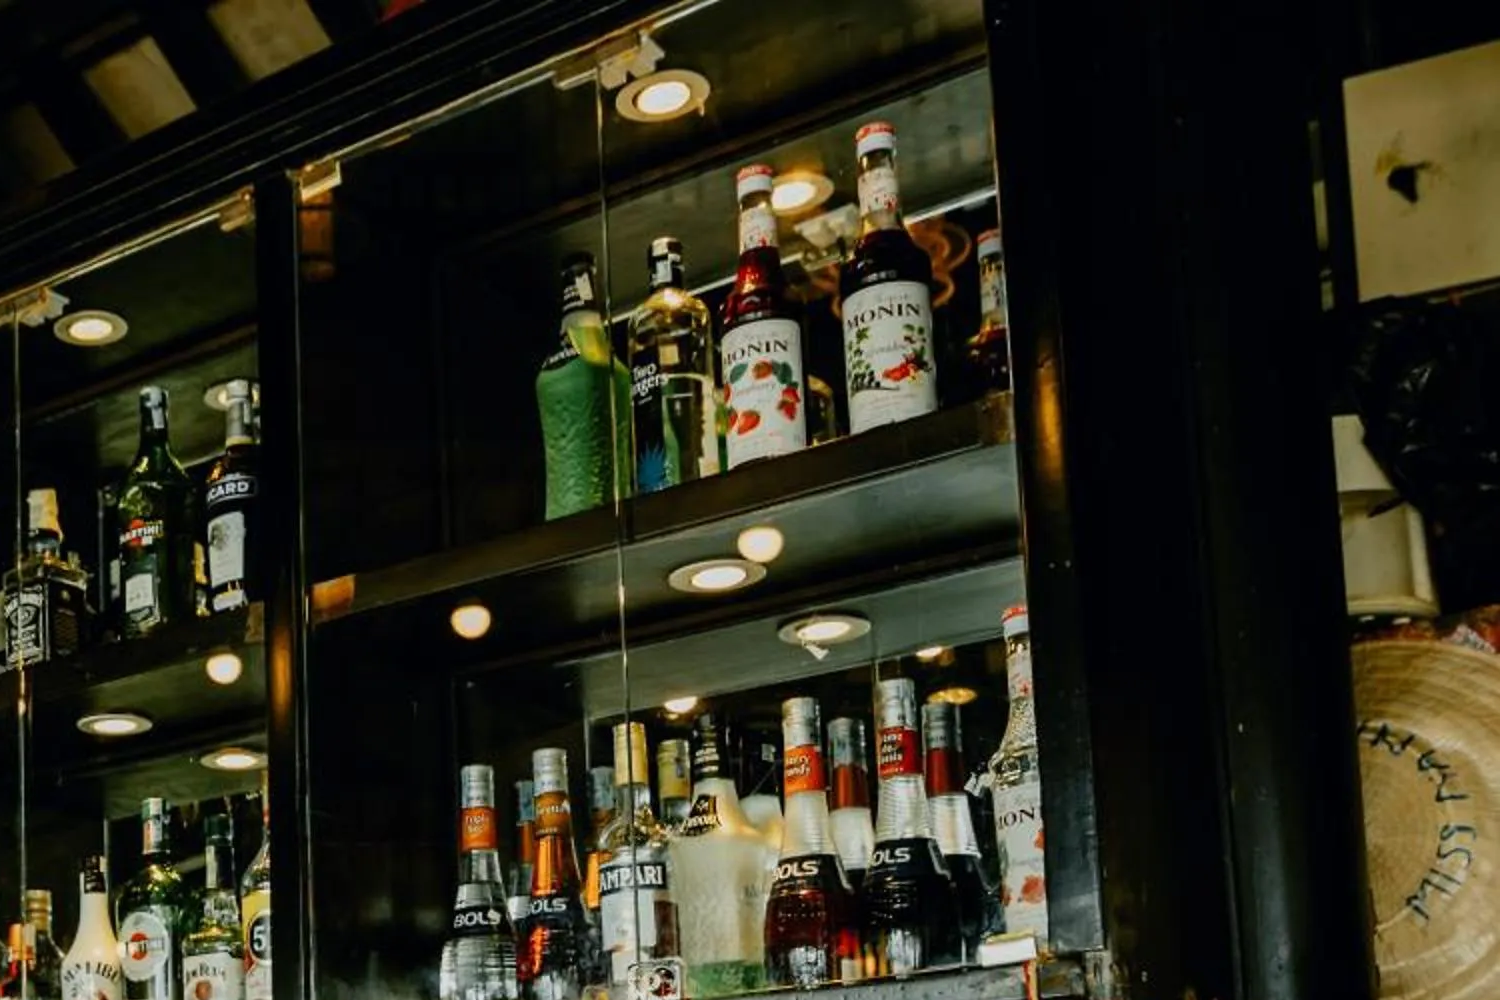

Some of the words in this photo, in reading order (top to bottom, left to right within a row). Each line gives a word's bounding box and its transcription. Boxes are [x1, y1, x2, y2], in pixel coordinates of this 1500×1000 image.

[846, 303, 921, 328] MONIN
[872, 847, 912, 868] OLS
[601, 864, 665, 891] AMPARI
[530, 897, 568, 915] OLS
[454, 911, 501, 929] BOLS
